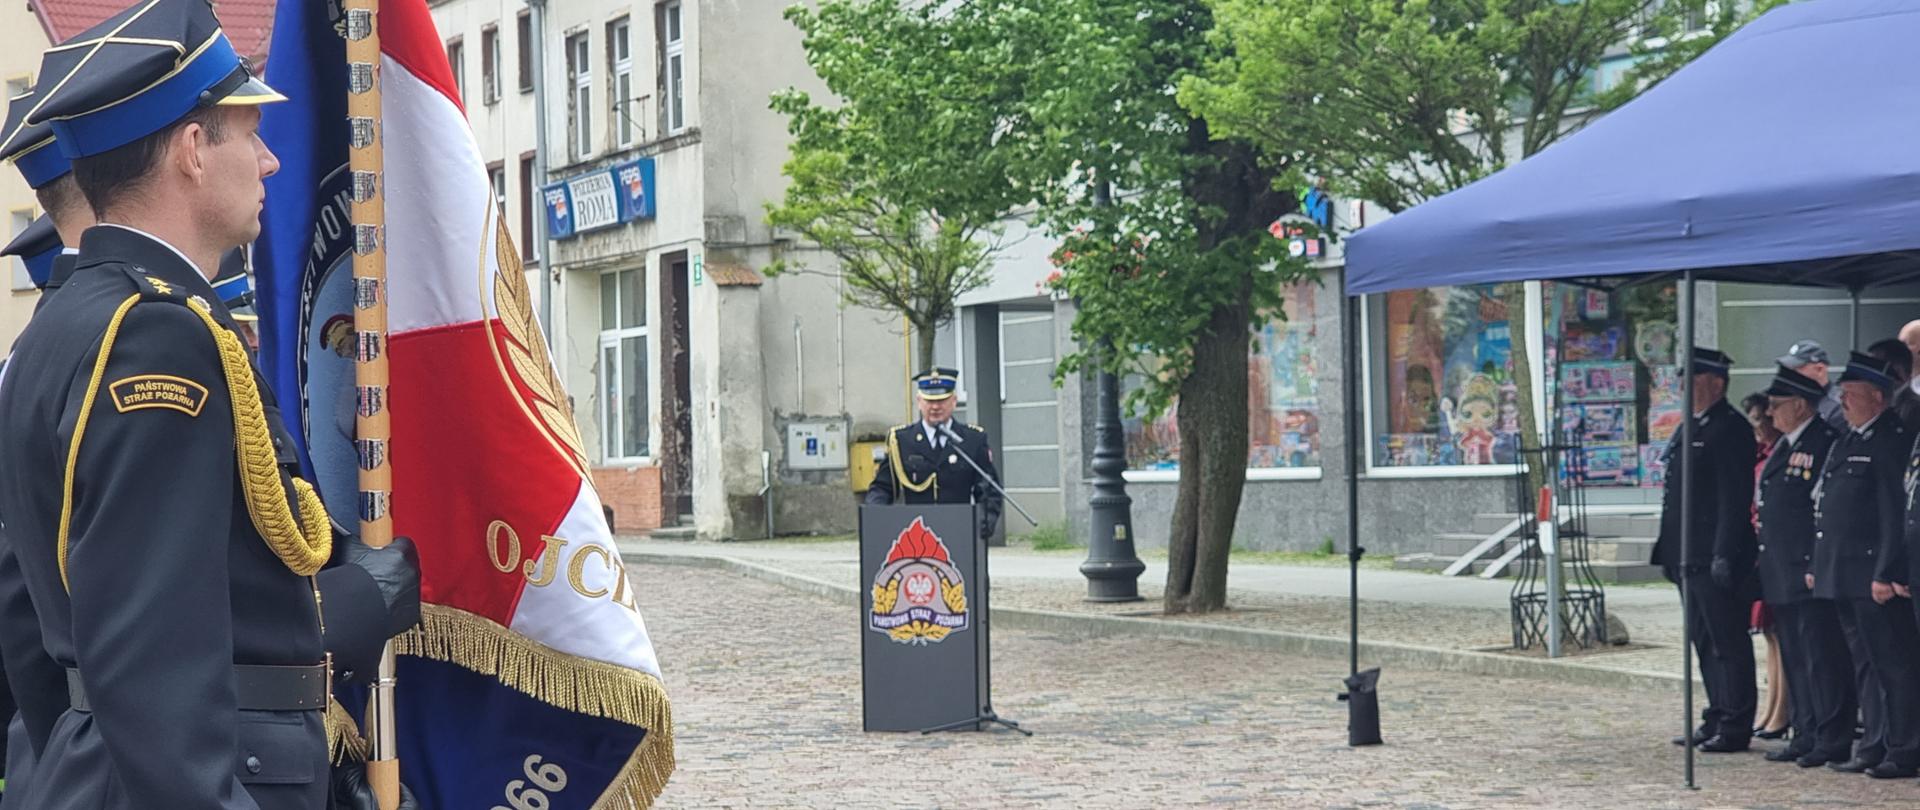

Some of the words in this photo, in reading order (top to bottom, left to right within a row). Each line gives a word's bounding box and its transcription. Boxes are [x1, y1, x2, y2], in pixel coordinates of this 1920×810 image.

[572, 174, 612, 197] PIZZERIA
[577, 193, 616, 227] ROMA
[134, 381, 187, 395] PAŃSTWOWA
[490, 754, 568, 810] 66
